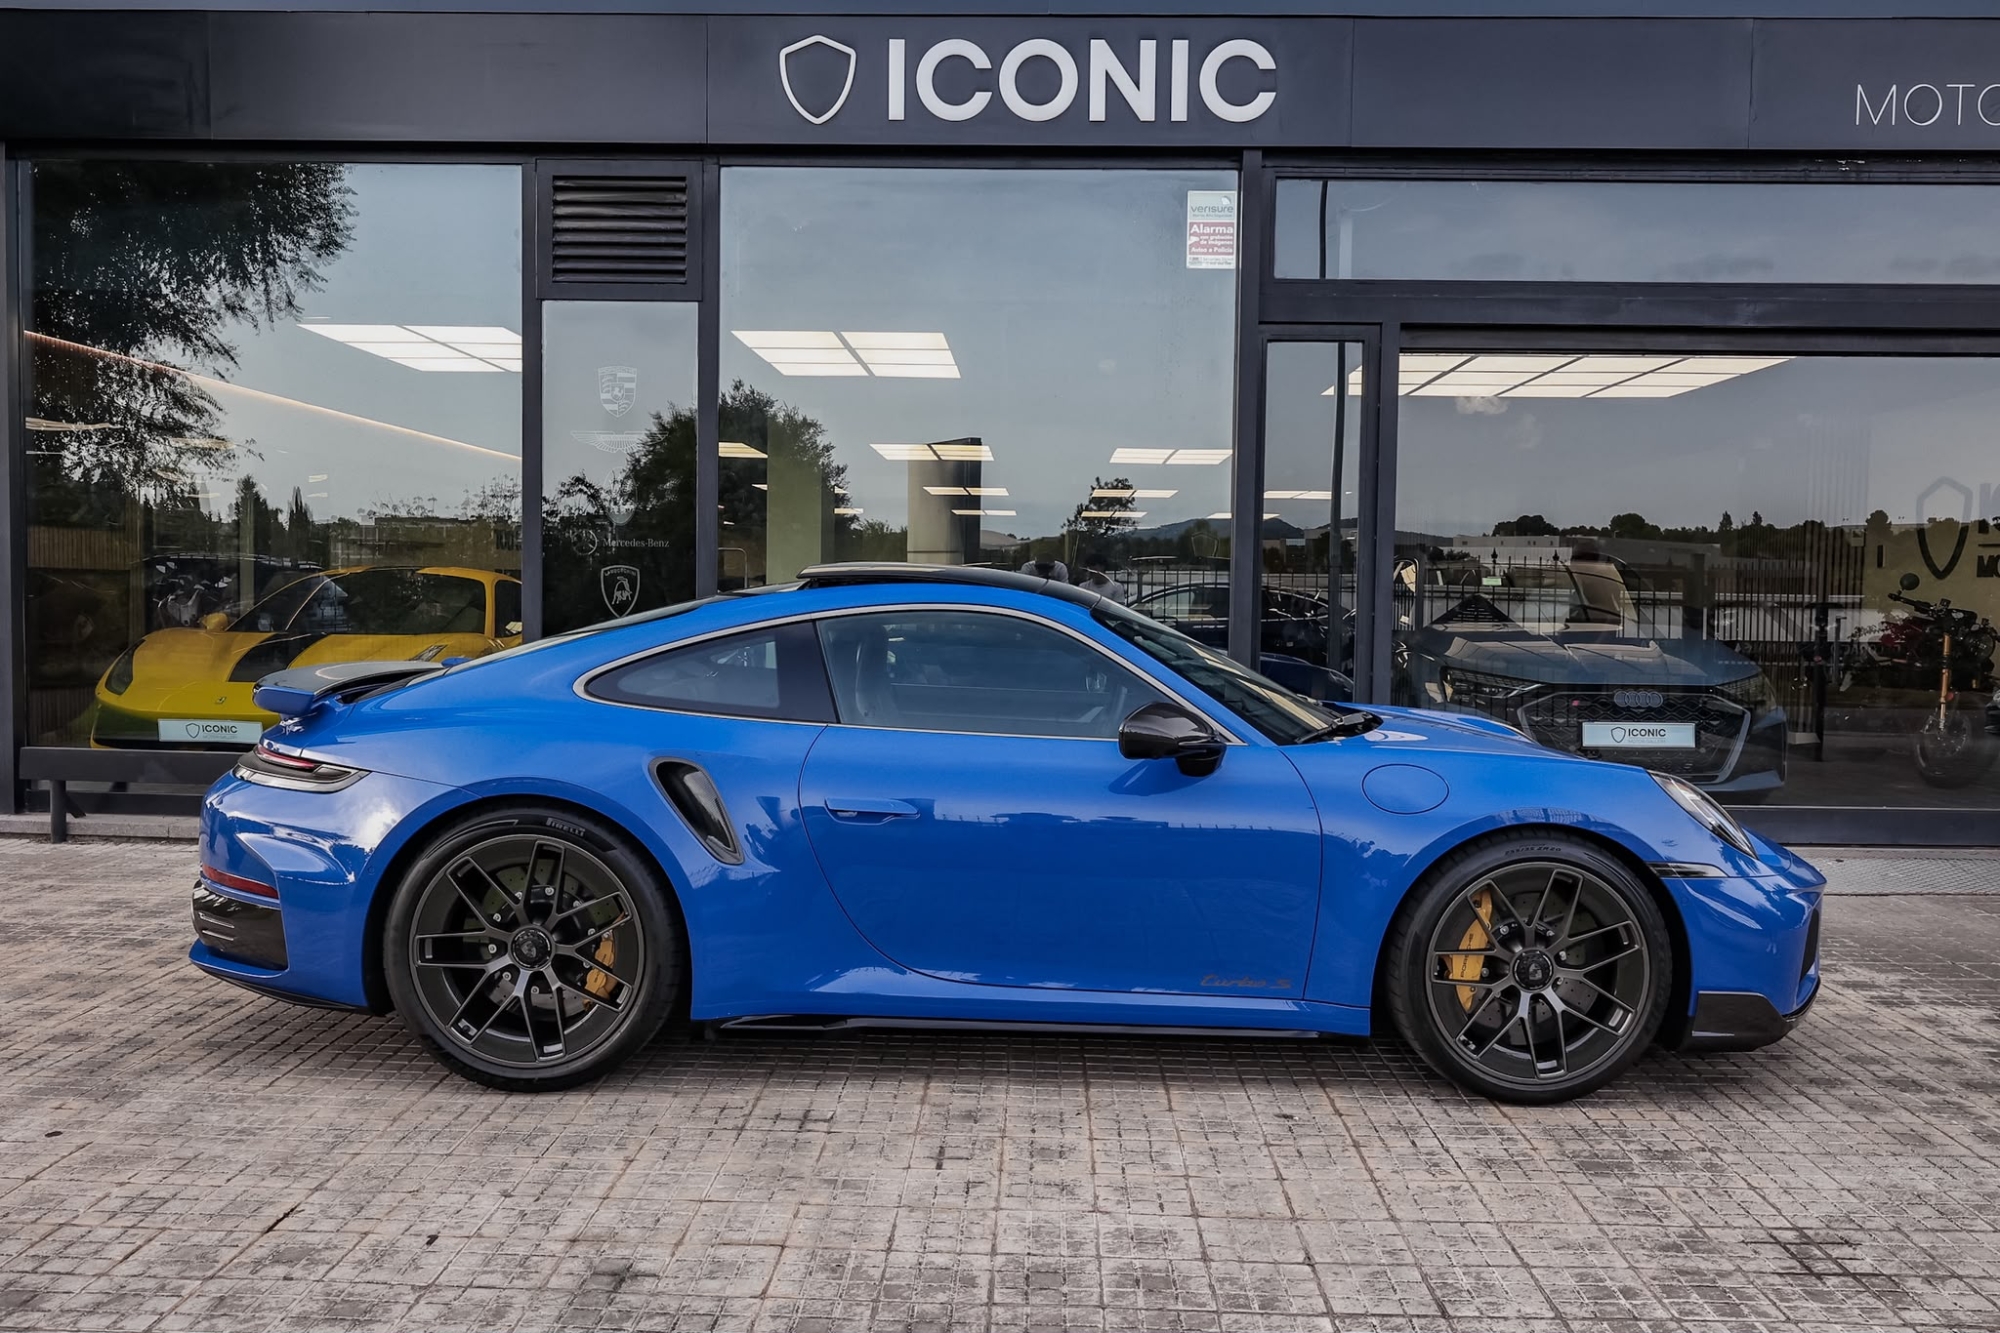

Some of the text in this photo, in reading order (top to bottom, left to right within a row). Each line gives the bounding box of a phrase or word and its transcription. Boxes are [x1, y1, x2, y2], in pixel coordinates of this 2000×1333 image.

[888, 38, 1277, 123] ICONIC
[1856, 83, 2000, 126] MOTO
[1190, 205, 1234, 213] verisure
[1190, 224, 1234, 234] Alarma
[603, 538, 670, 548] Mercedes-Benz
[201, 724, 238, 734] ICONIC
[1628, 728, 1667, 737] ICONIC
